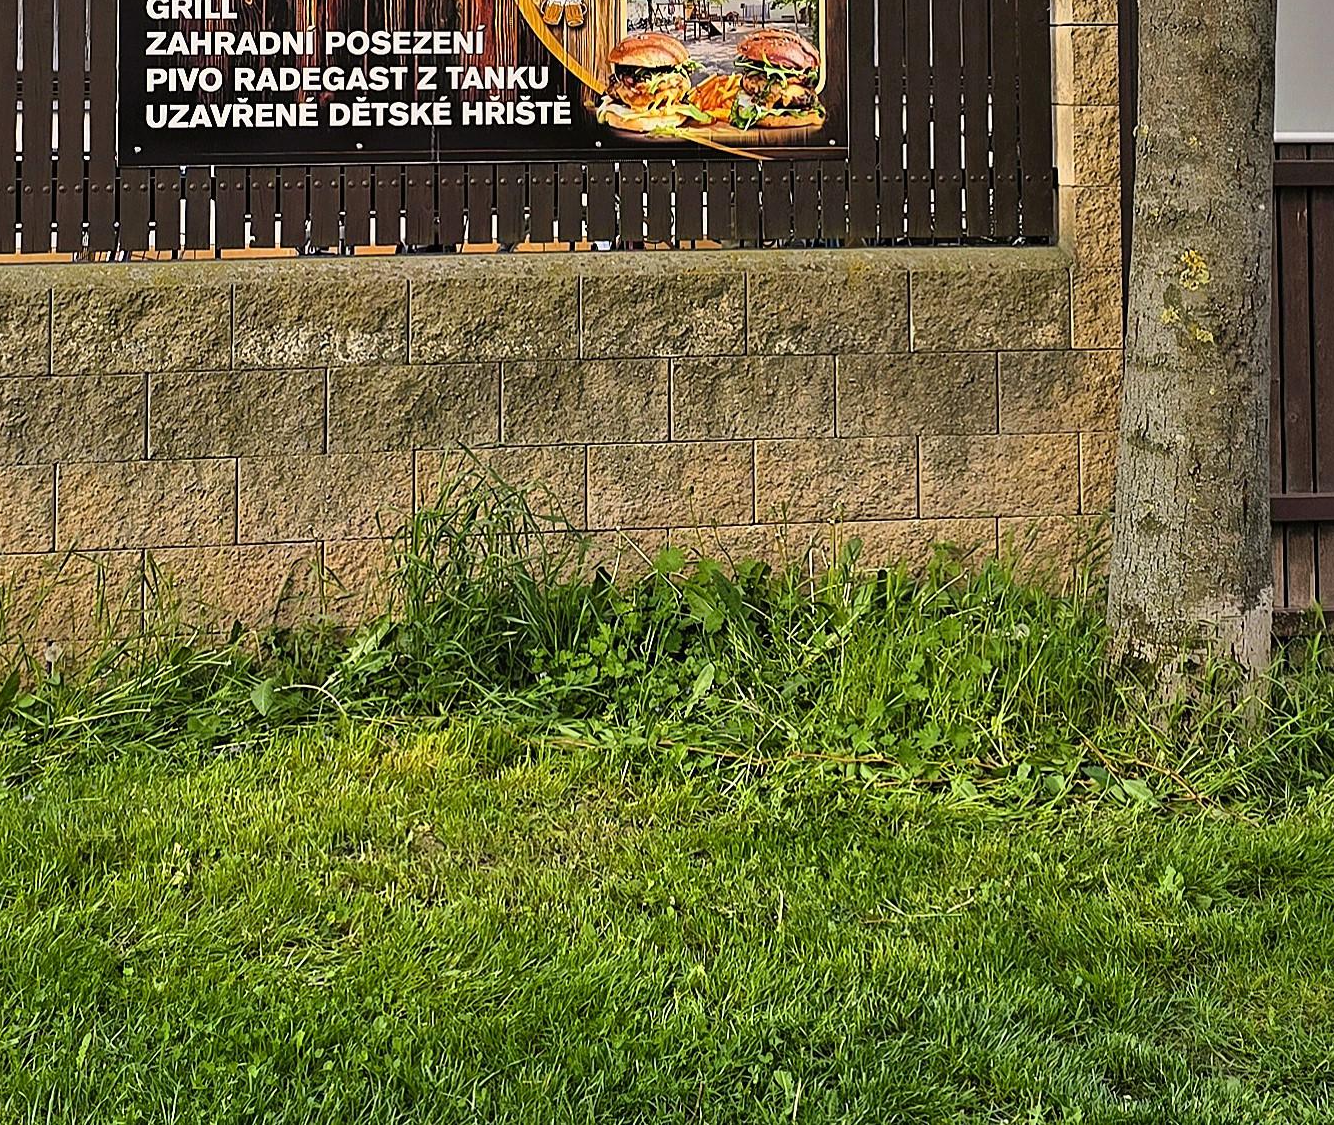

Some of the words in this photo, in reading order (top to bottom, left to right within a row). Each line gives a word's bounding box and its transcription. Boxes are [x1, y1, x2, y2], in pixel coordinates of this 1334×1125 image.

[146, 25, 316, 56] ZAHRADNÍ
[326, 24, 485, 56] POSEZENÍ
[146, 67, 223, 93] PIVO
[234, 66, 408, 92] RADEGAST
[417, 66, 437, 91] Z
[446, 66, 549, 91] TANKU
[146, 97, 319, 129] UZAVŘENÉ
[329, 96, 452, 128] DĚTSKÉ
[462, 94, 572, 127] HŘIŠTĚ
